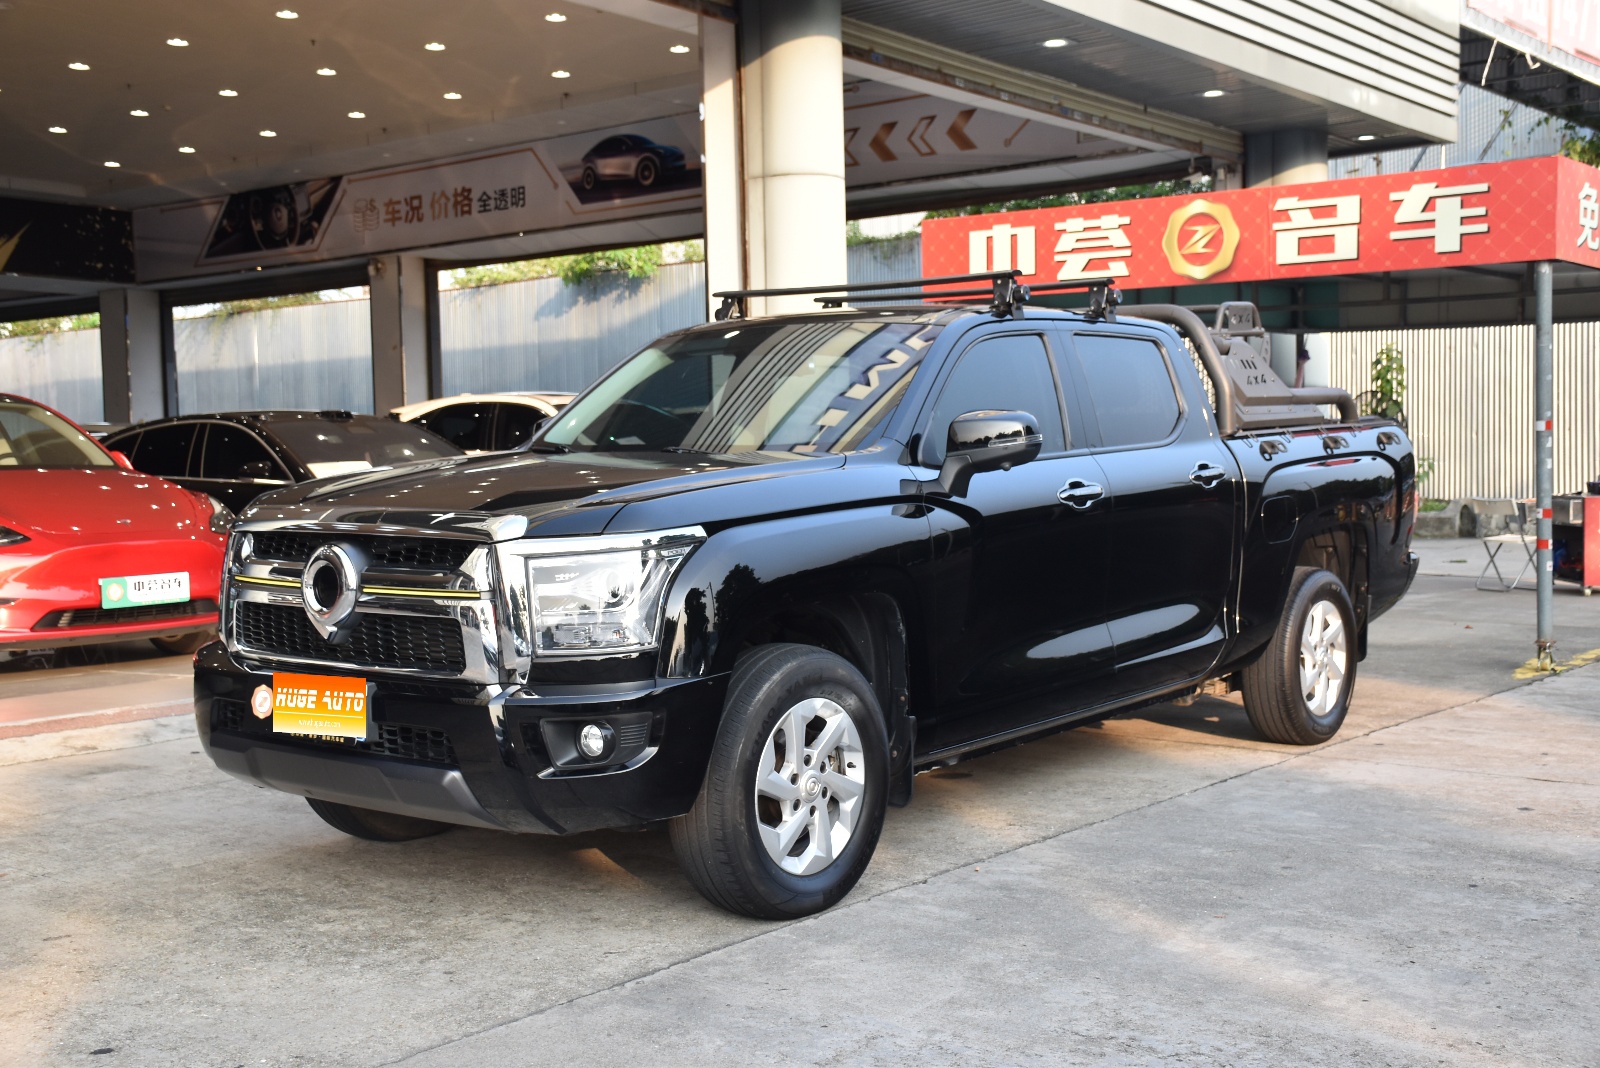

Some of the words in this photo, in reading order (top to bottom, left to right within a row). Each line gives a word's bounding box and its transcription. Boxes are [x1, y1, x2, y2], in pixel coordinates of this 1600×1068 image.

[383, 194, 424, 227] 车况
[430, 186, 474, 221] 价格
[477, 185, 526, 214] 全透明
[1272, 182, 1490, 266] 名车
[1577, 182, 1600, 251] 免
